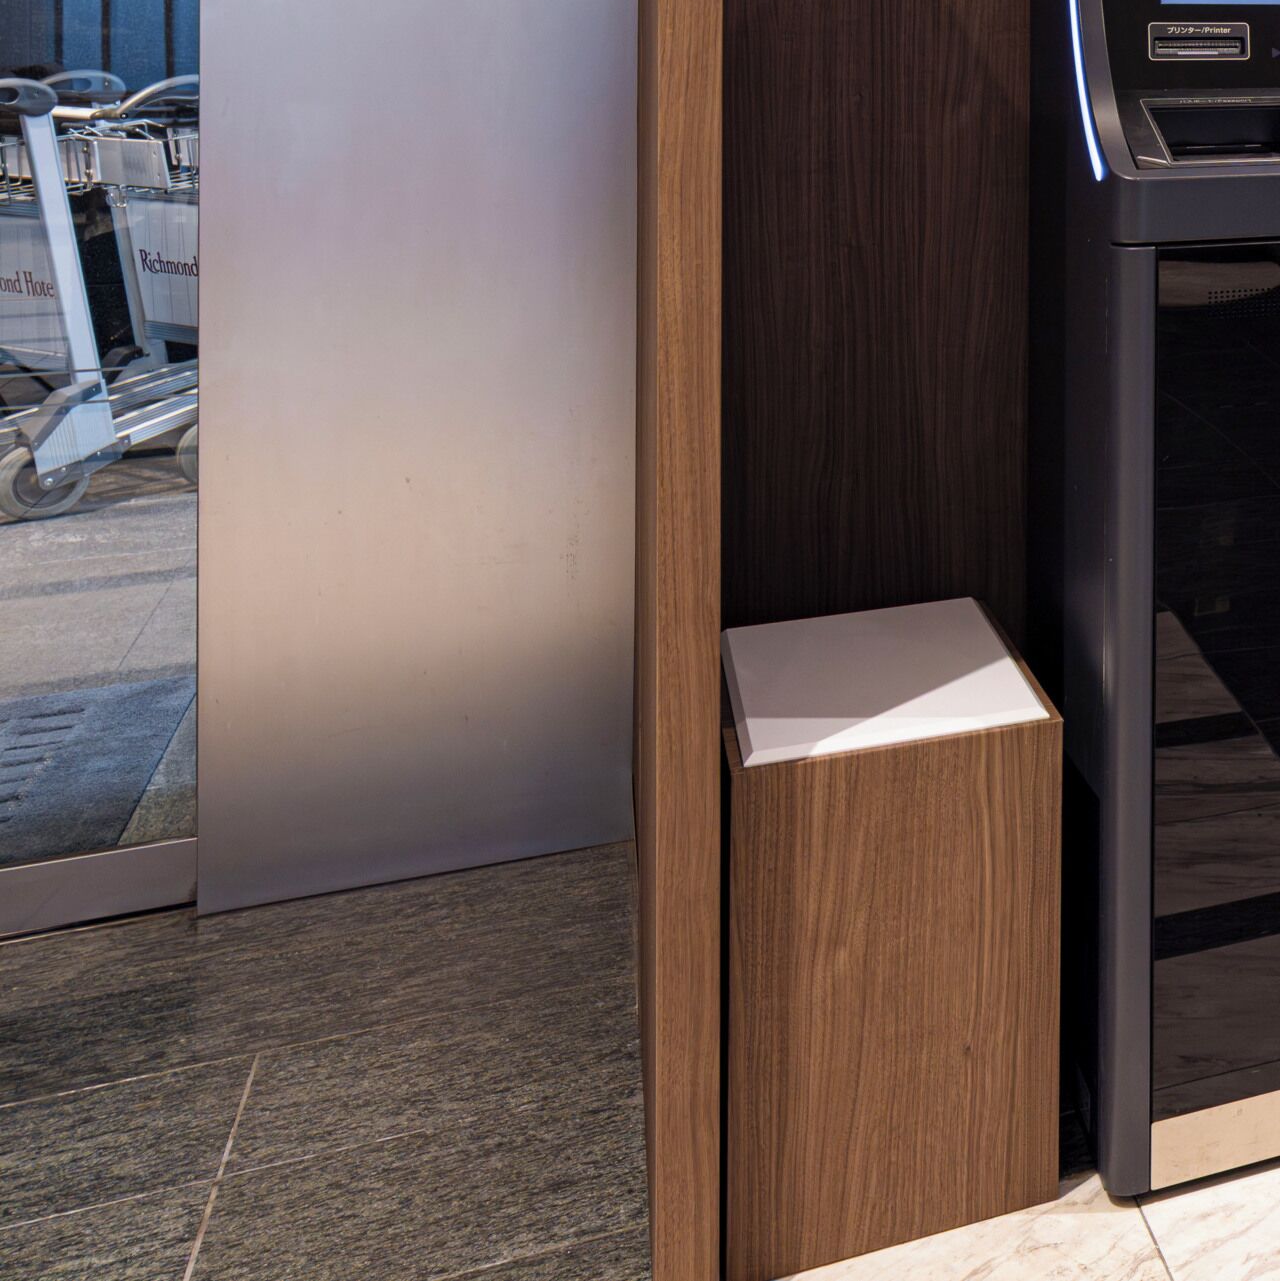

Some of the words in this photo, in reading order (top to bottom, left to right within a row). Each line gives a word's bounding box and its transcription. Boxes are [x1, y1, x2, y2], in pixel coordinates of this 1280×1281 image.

[1167, 26, 1232, 34] プリンター/Printer
[139, 249, 199, 277] Richmond
